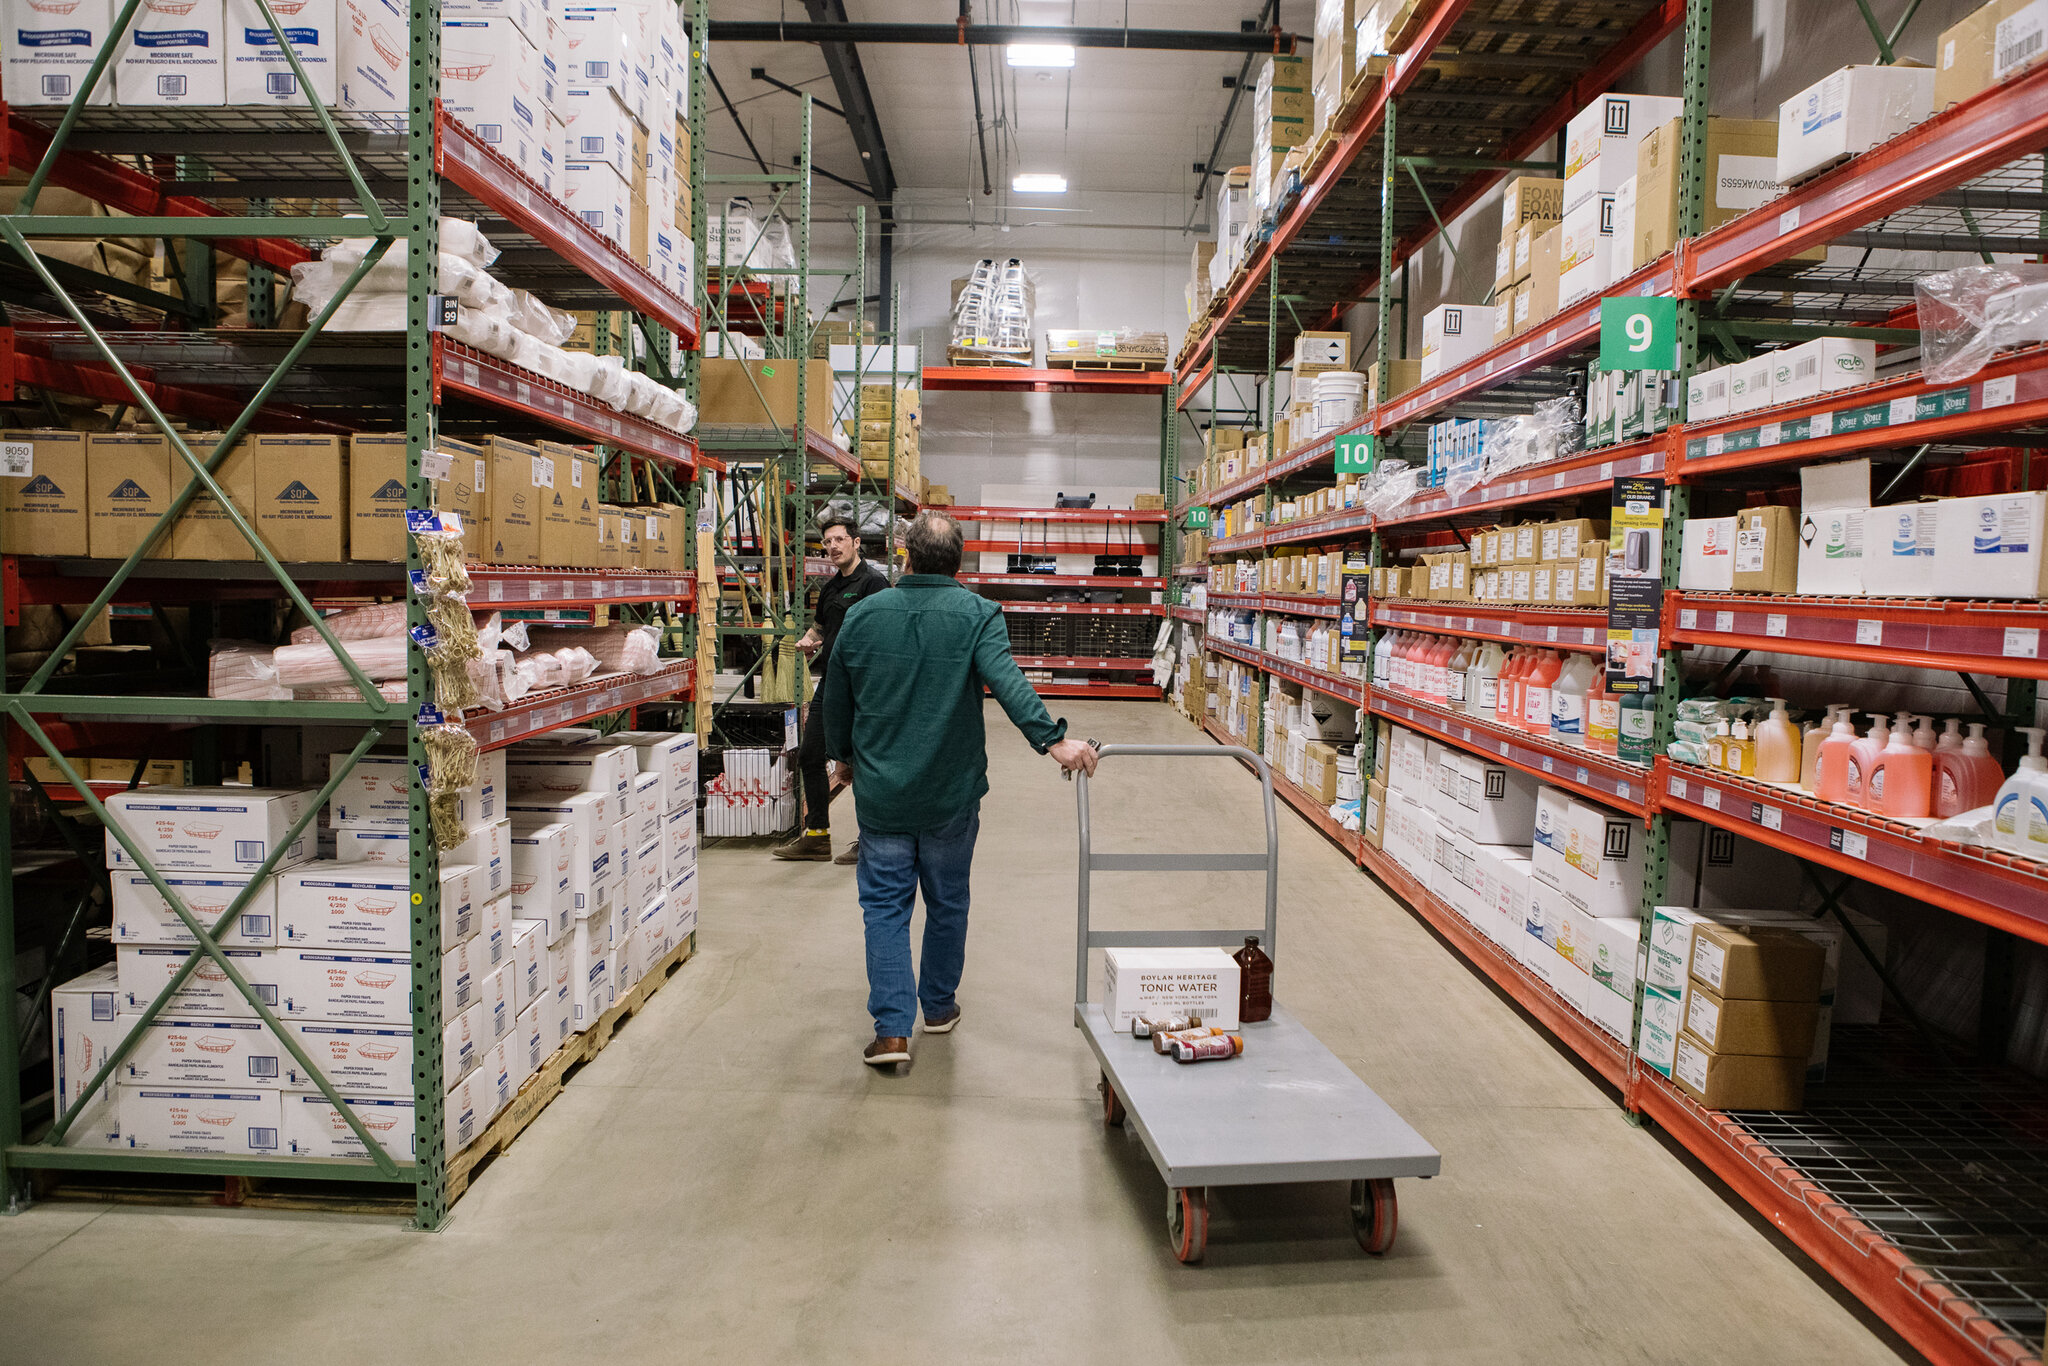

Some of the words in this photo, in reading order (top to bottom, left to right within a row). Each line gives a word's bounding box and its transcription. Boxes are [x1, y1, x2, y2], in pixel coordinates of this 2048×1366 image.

[1522, 187, 1563, 200] FOAM
[1522, 200, 1563, 213] FOAM
[445, 300, 457, 308] BIN
[444, 312, 456, 322] 99
[1625, 313, 1652, 352] 9
[5, 446, 29, 456] 9050
[1340, 443, 1369, 465] 10
[35, 483, 53, 493] SQP
[123, 487, 140, 497] SQP
[386, 488, 404, 497] SQP
[290, 489, 308, 499] SQP
[1192, 511, 1205, 522] 10
[1652, 944, 1682, 964] DISINFECTING
[1658, 956, 1671, 968] WIPES
[1140, 984, 1174, 992] TONIC
[1179, 983, 1217, 992] WATER
[1644, 1019, 1672, 1042] DISINFECTING
[1651, 1032, 1663, 1044] WIPES
